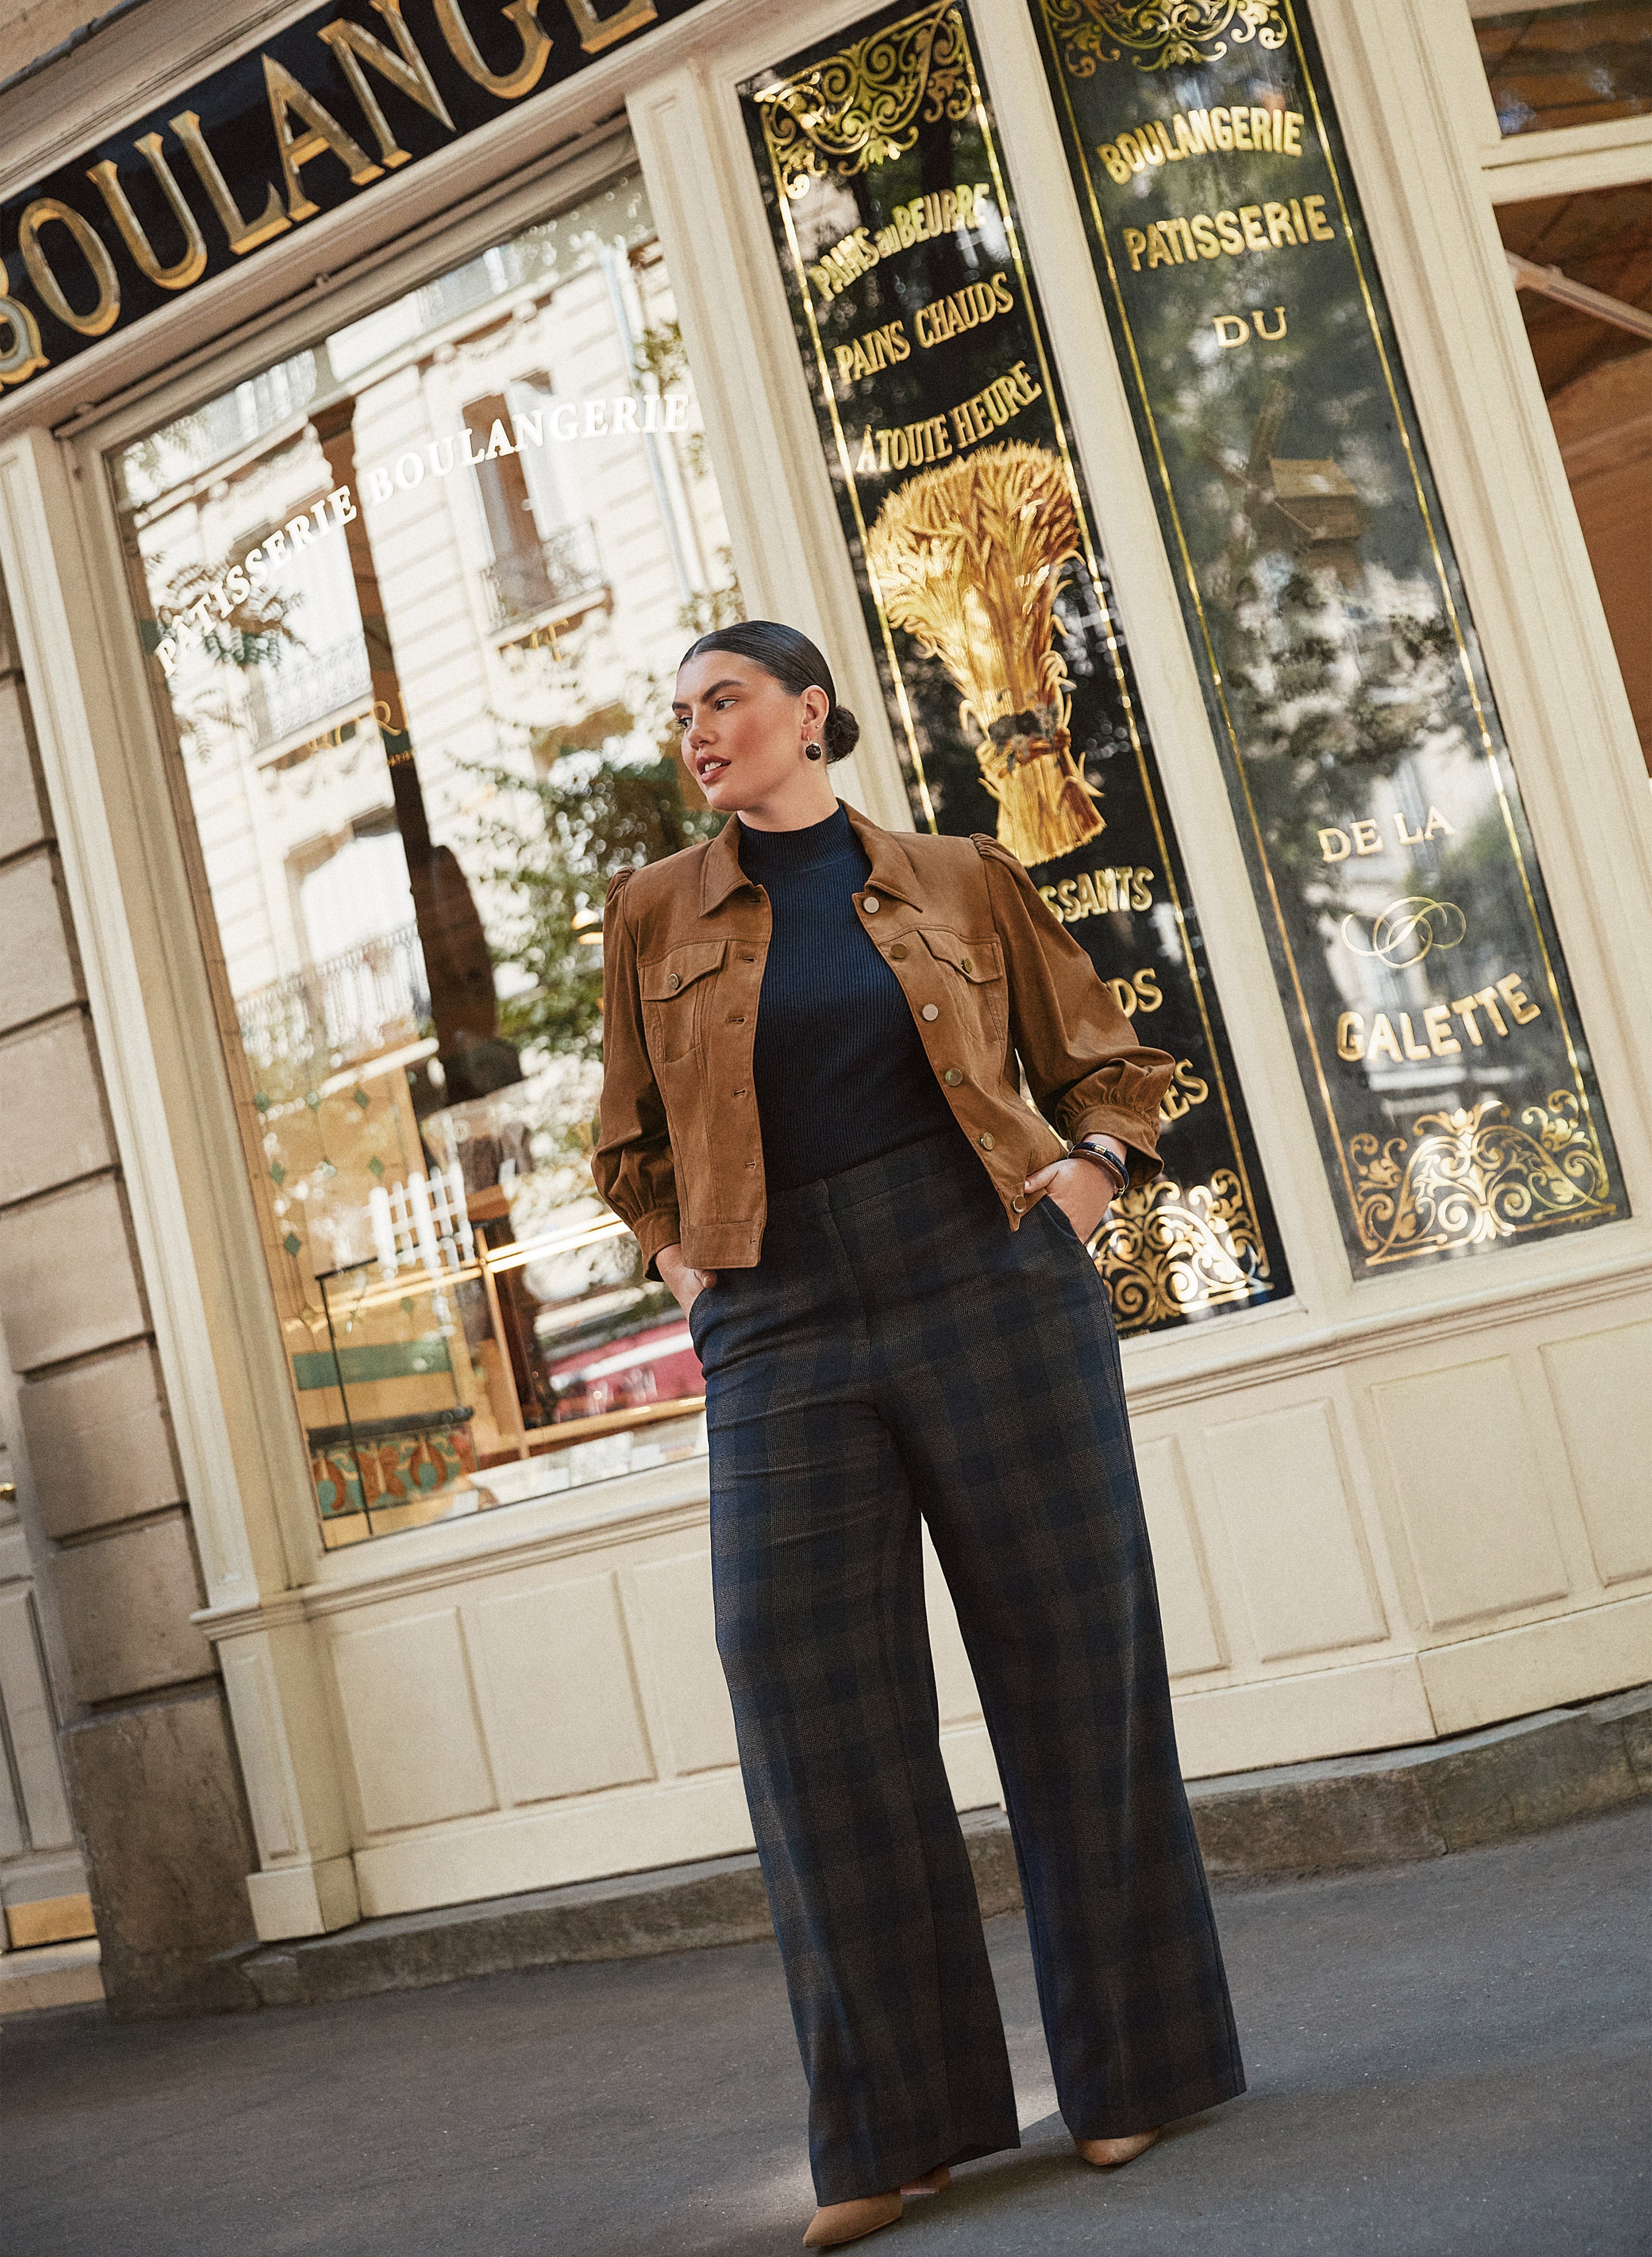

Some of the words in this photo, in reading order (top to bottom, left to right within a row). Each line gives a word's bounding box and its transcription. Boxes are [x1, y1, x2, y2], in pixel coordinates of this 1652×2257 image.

[1097, 106, 1304, 185] BOULANGERIE
[808, 227, 880, 302] PAINS
[891, 182, 990, 249] BEURRE
[1121, 194, 1335, 272] PATISSERIE
[833, 320, 911, 386] PAINS
[914, 271, 1014, 349] CHAUDS
[1213, 306, 1288, 348] DU
[368, 393, 689, 507] BOULANGERIE
[875, 413, 953, 473] TOUTE
[948, 360, 1043, 449] HEURE
[1318, 819, 1383, 862] DE
[1392, 805, 1456, 845] LA
[1337, 972, 1541, 1062] GALETTE
